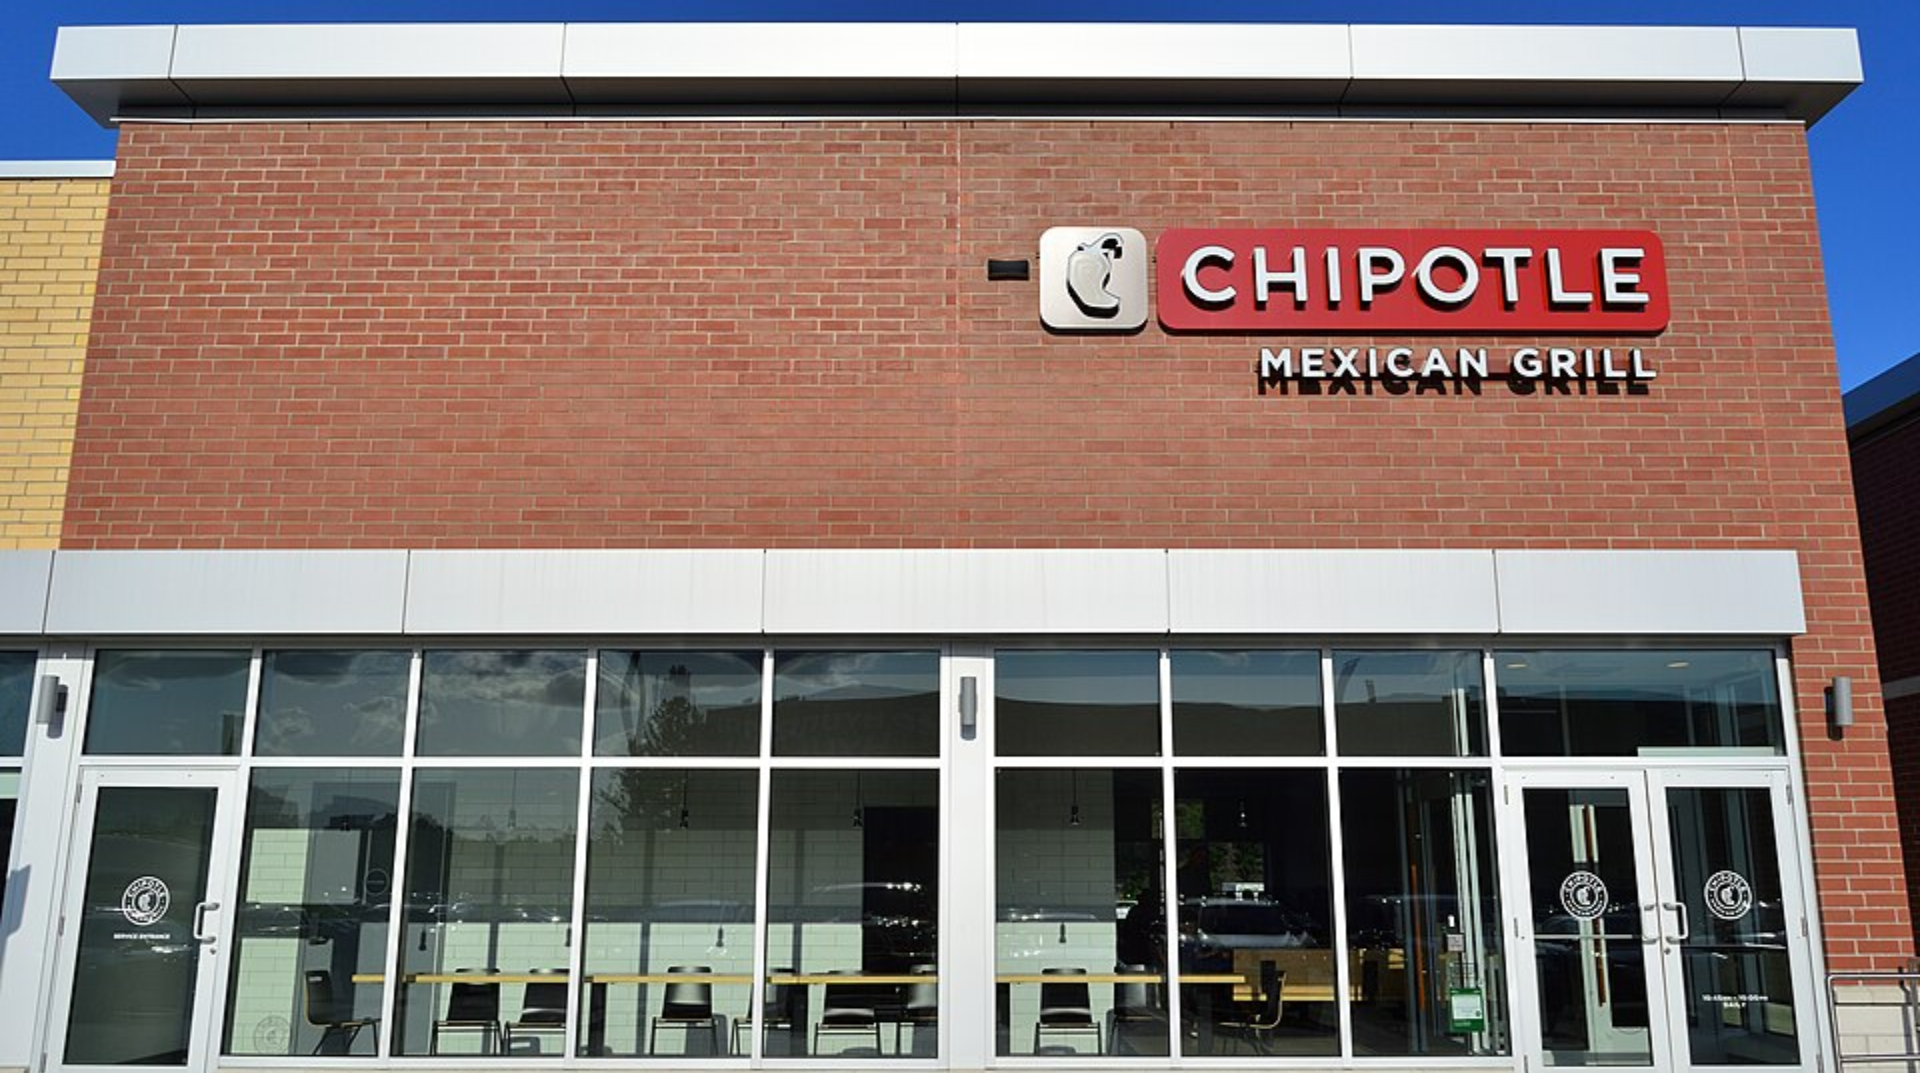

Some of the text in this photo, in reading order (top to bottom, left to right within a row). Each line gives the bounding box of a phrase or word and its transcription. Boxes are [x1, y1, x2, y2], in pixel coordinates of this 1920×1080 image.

[1182, 246, 1650, 305] CHIPOTLE
[1259, 347, 1657, 379] MEXICAN GRILL
